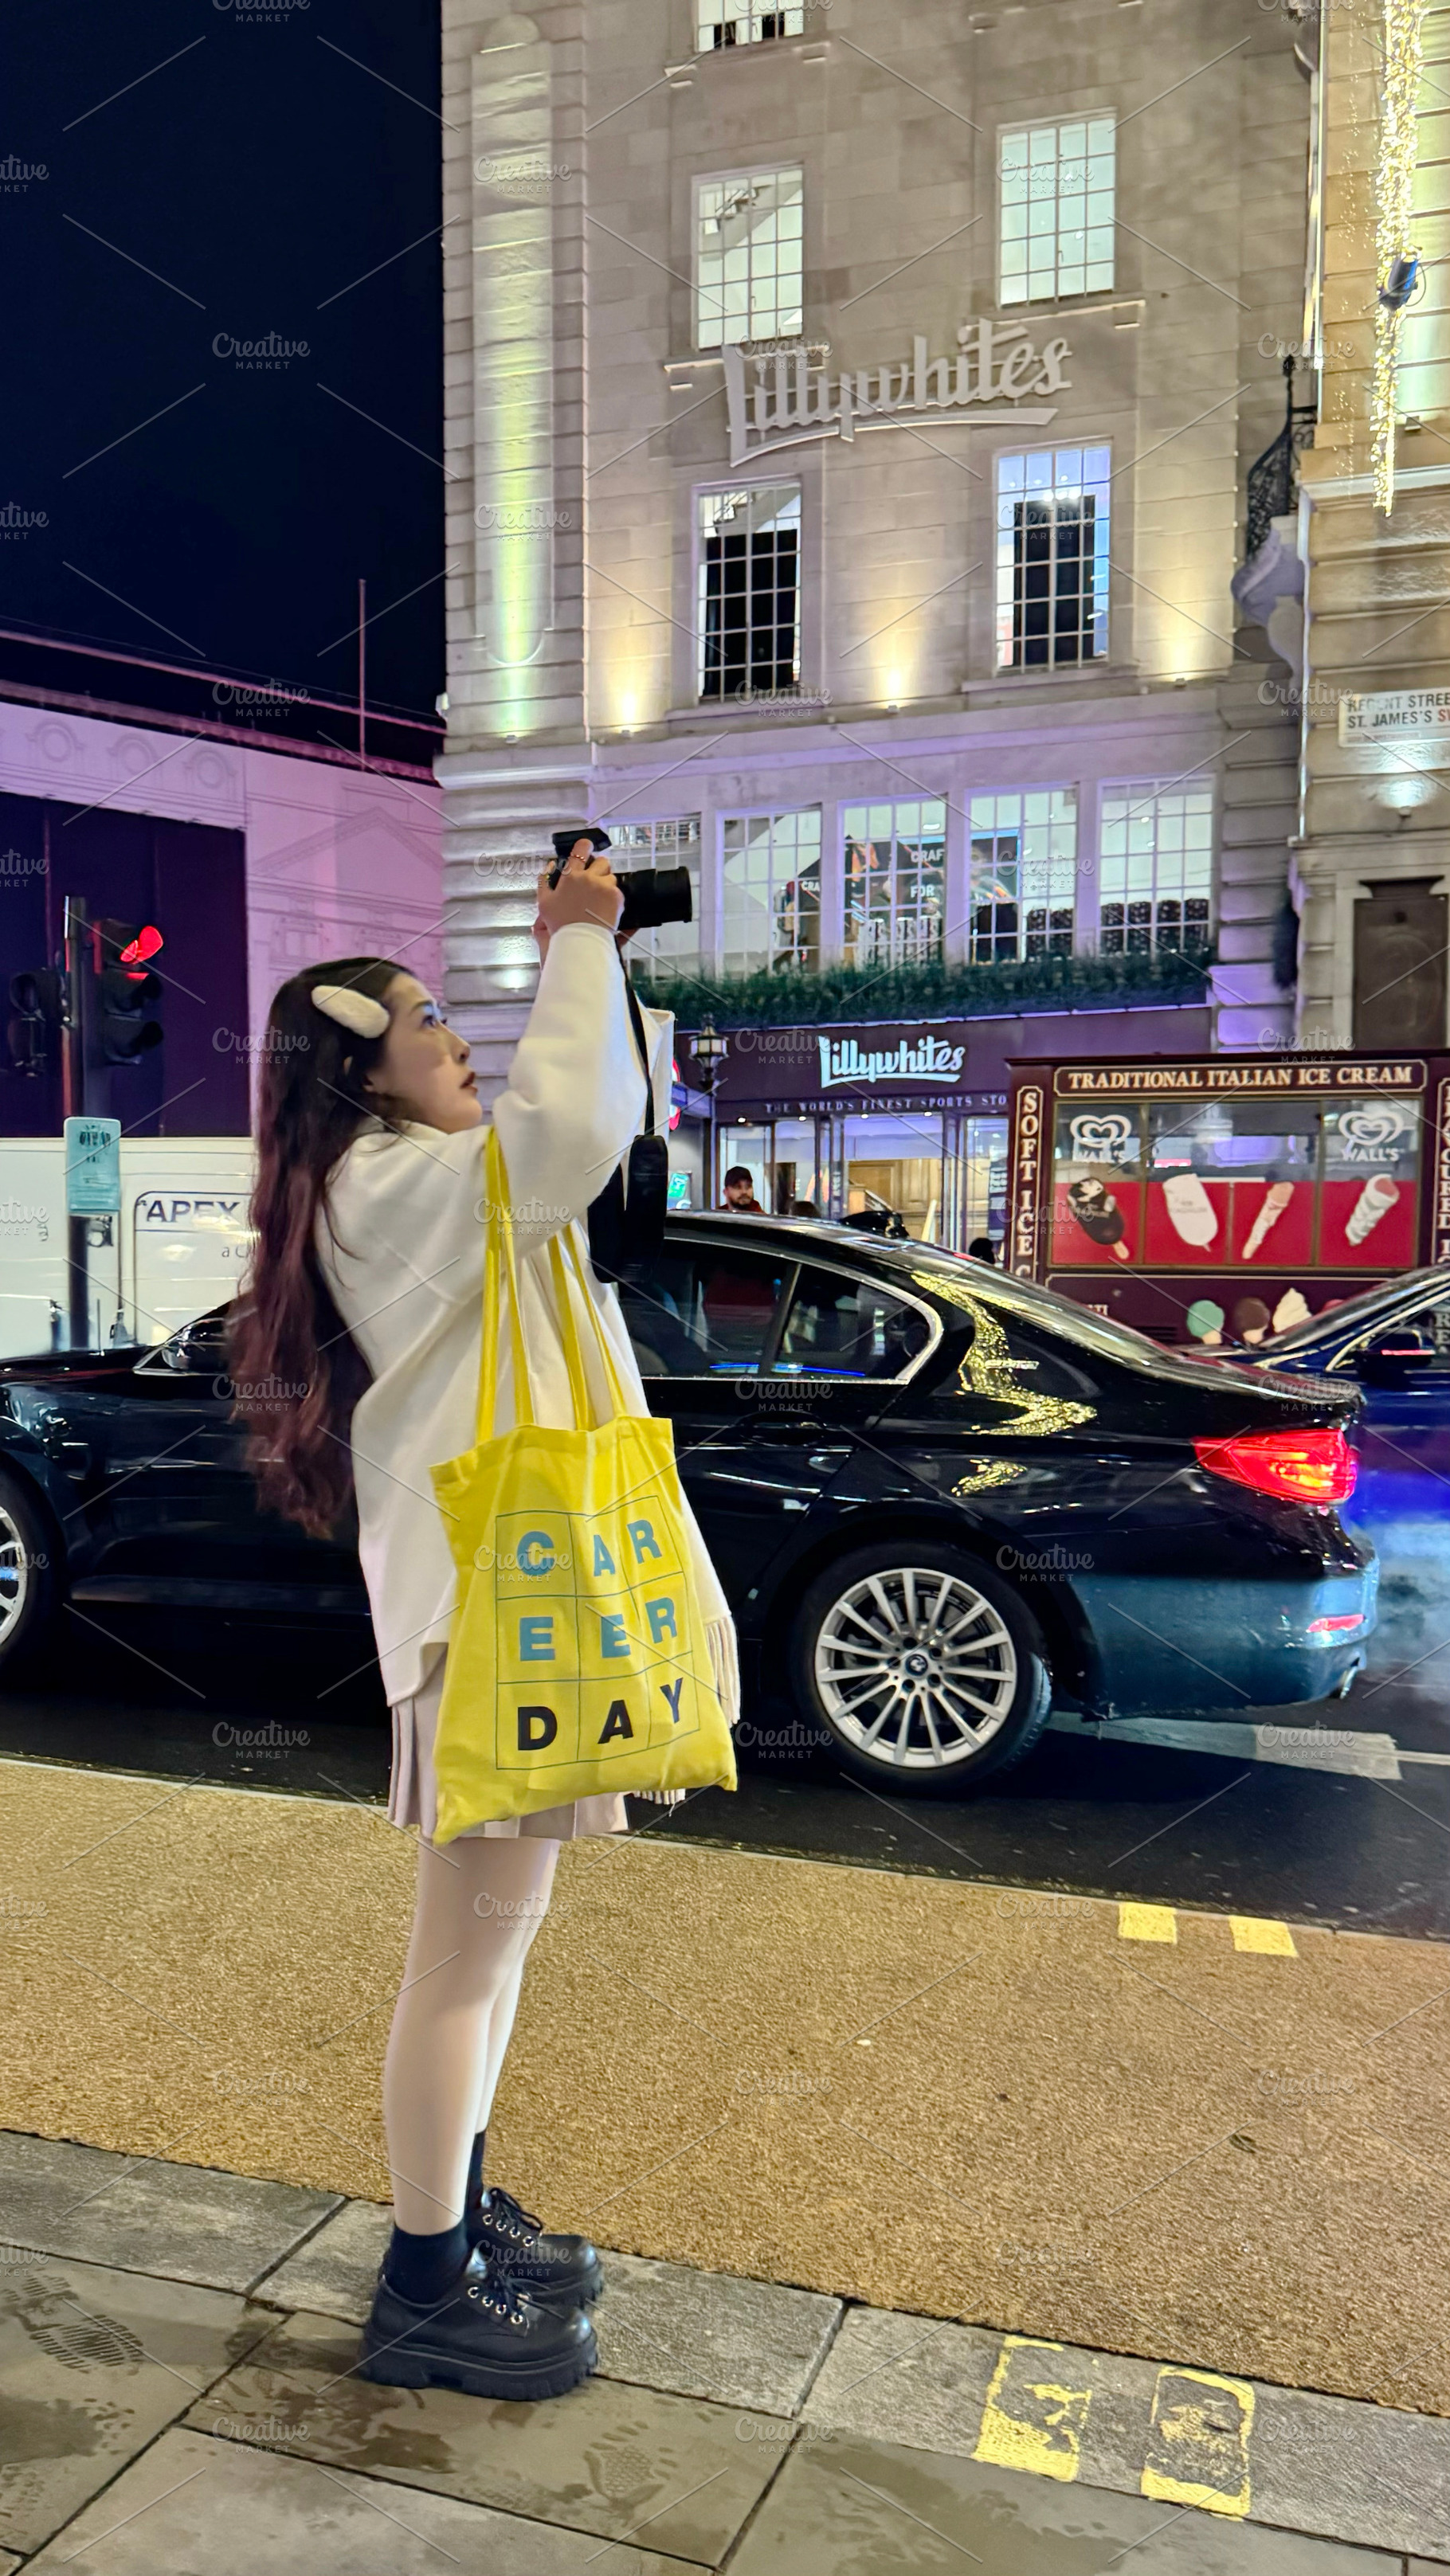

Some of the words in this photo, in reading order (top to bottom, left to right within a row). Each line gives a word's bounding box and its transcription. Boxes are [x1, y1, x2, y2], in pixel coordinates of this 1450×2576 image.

[723, 319, 1072, 468] Lillywhites
[1372, 711, 1432, 727] JAMES'S
[910, 884, 935, 898] FOR
[818, 1035, 966, 1089] Lillywhites
[1068, 1071, 1204, 1090] TRADITIONAL
[1207, 1069, 1296, 1086] ITALIAN
[1298, 1067, 1331, 1085] ICE
[1336, 1066, 1413, 1084] CREAM
[798, 1100, 854, 1112] WORLD'S
[862, 1098, 911, 1110] FINEST
[920, 1095, 972, 1108] SPORTS
[1019, 1092, 1038, 1181] SOFT
[1340, 1148, 1401, 1162] WALL'S
[1016, 1190, 1035, 1257] ICE
